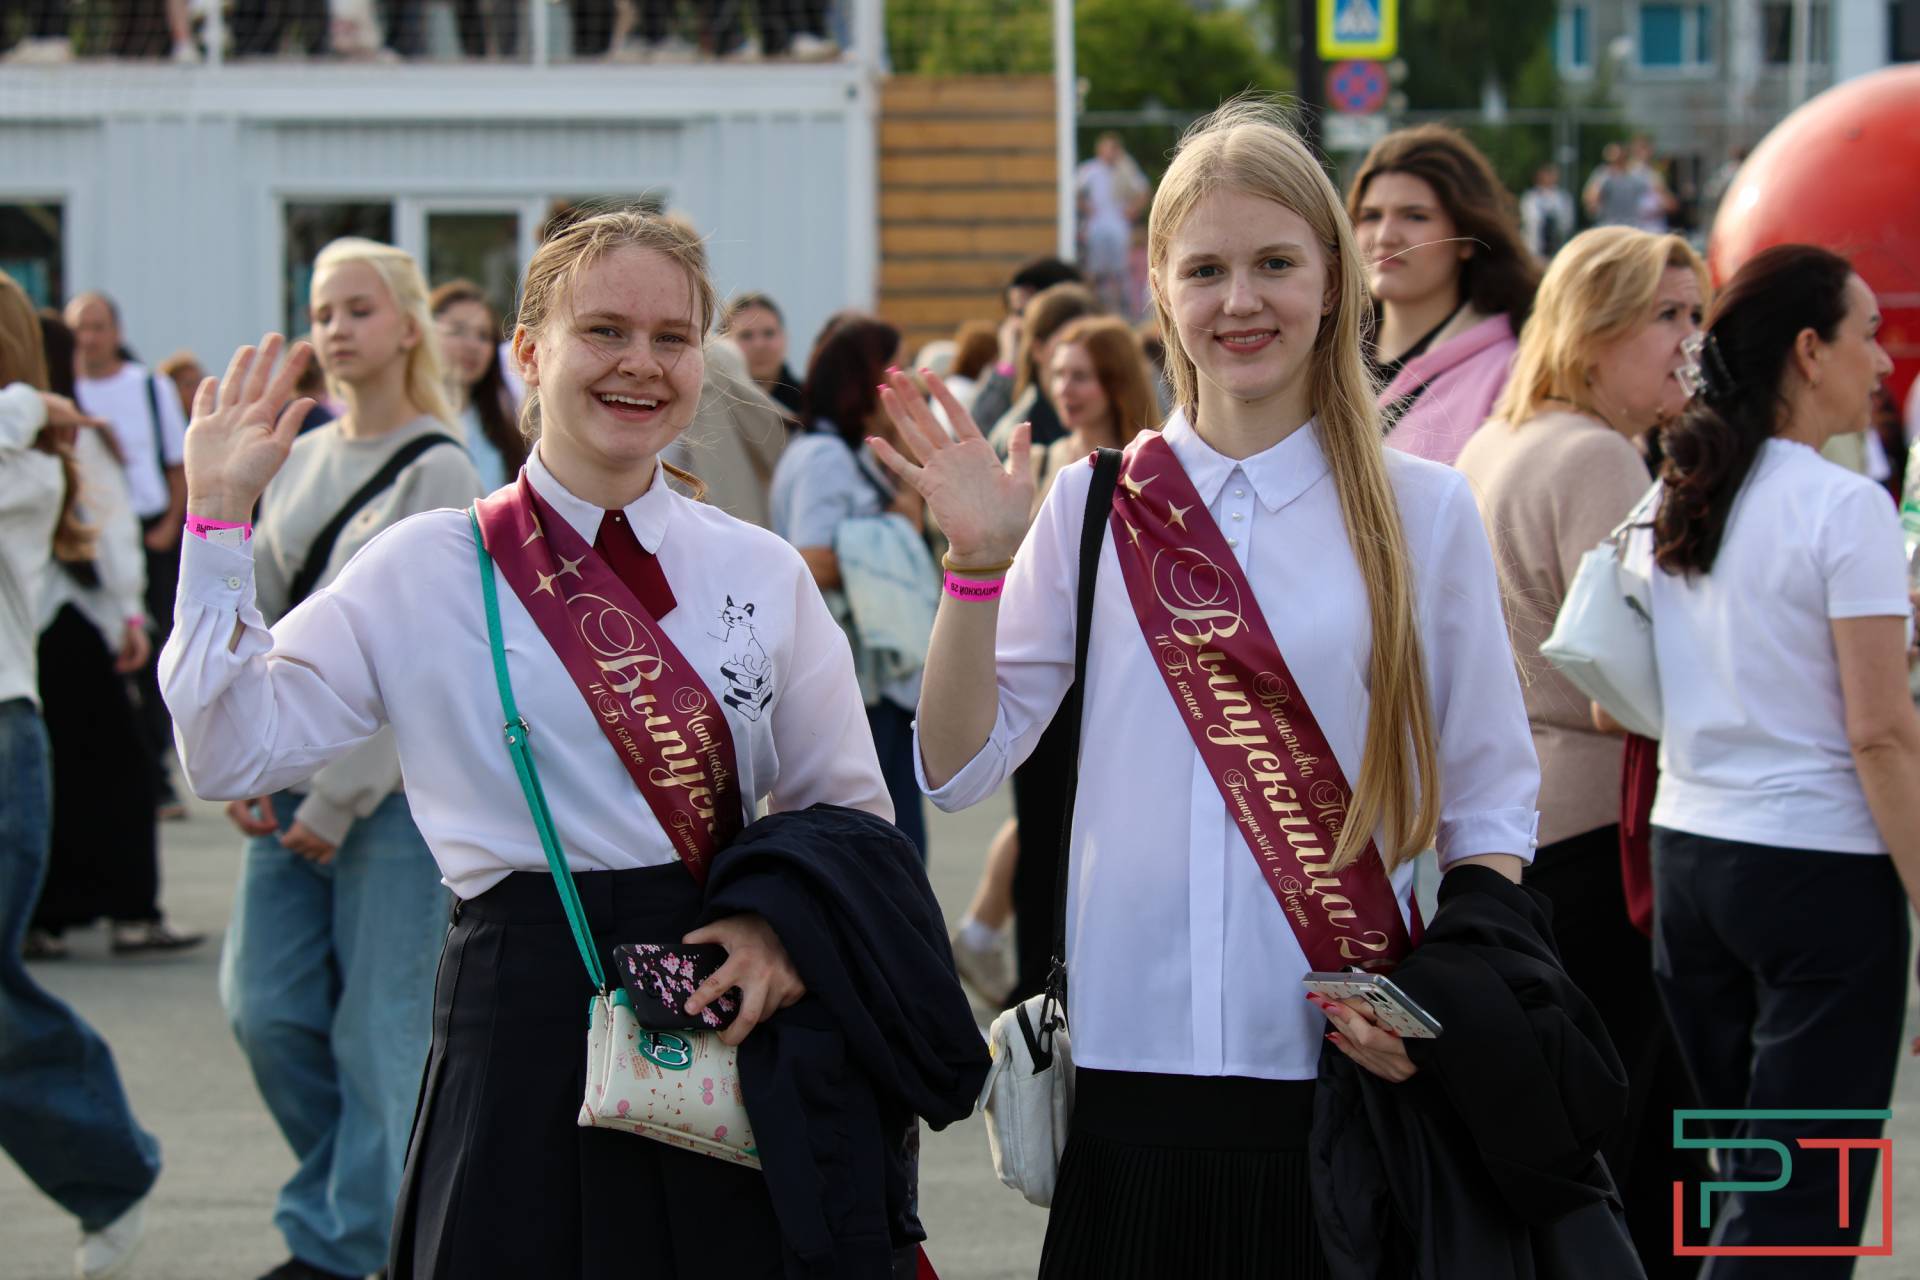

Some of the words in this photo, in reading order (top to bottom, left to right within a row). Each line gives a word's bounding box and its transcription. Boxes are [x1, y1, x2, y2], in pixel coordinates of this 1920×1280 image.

[567, 594, 719, 840] Выпуск
[616, 727, 645, 765] класс
[1152, 547, 1357, 928] Выпускница
[1177, 681, 1204, 720] класс
[1253, 672, 1319, 778] Васильева
[1223, 769, 1260, 833] Гимназия
[1279, 875, 1310, 928] Казань
